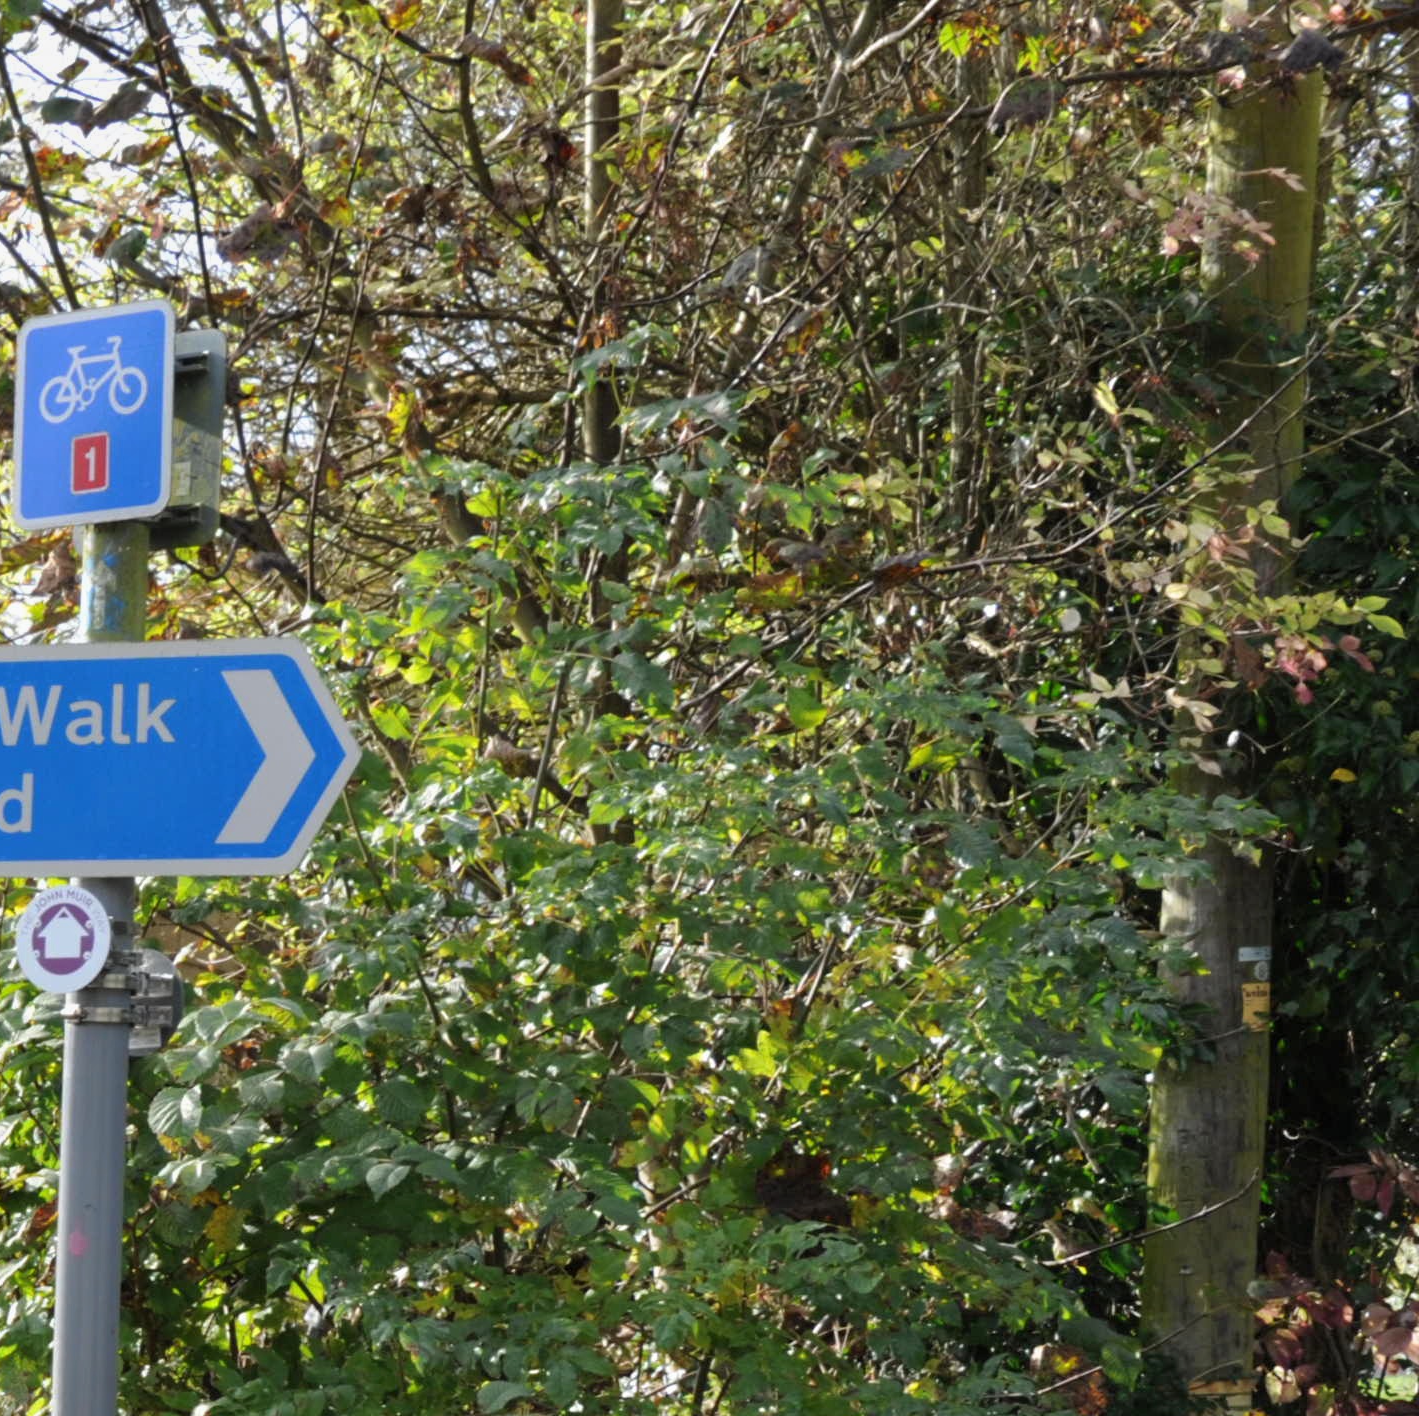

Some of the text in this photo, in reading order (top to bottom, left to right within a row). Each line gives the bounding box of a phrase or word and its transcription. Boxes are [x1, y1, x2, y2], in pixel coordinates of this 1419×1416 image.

[83, 446, 96, 482] 1
[34, 890, 63, 912] JOHN
[66, 889, 93, 908] MUIR
